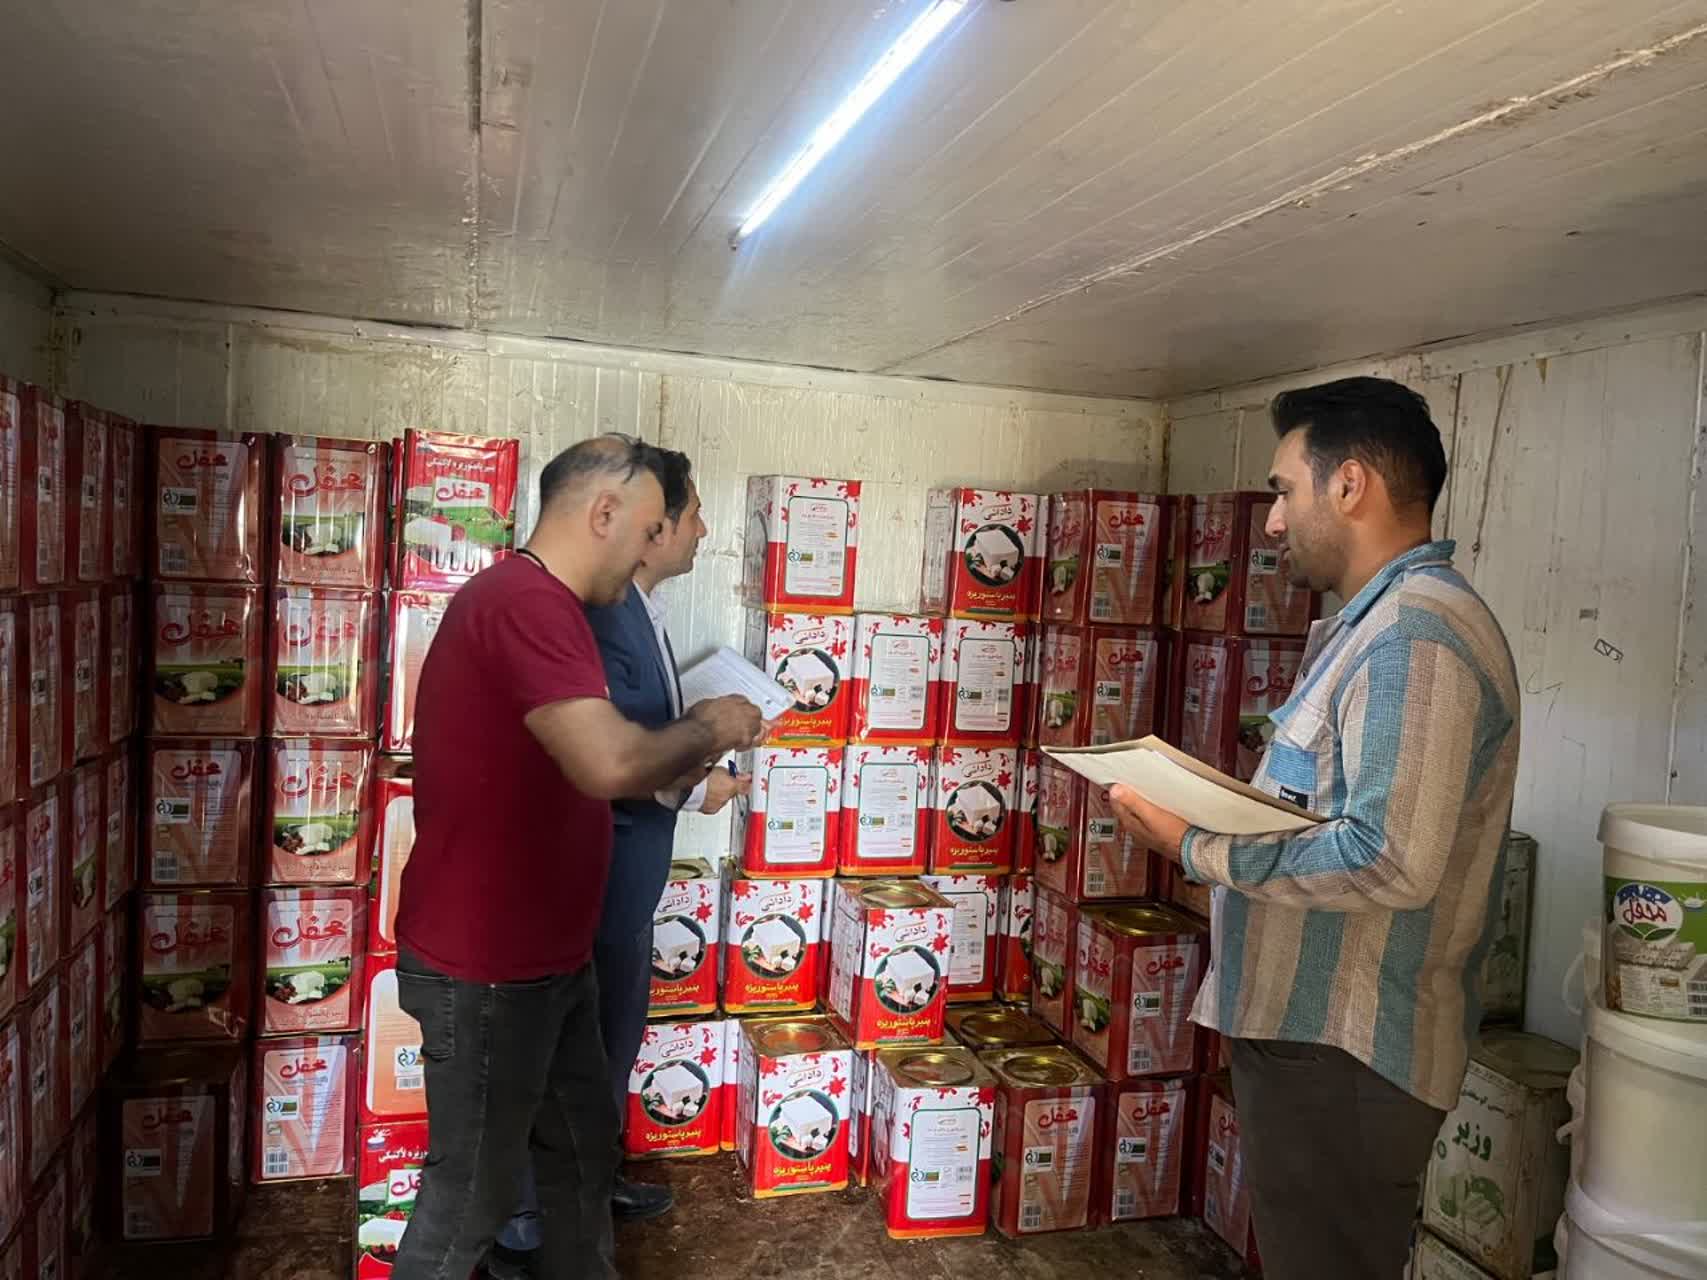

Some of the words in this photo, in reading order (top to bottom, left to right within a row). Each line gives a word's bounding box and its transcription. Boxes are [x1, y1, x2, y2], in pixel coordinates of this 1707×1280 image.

[288, 464, 366, 497] محفل
[436, 483, 486, 501] محفل
[1108, 510, 1145, 529] محفل
[1108, 648, 1144, 665] محفل
[171, 759, 222, 780] محفل
[272, 915, 346, 948] محفل
[1146, 954, 1185, 975] محفل
[280, 1056, 327, 1078] محفل
[1038, 1106, 1078, 1128] محفل
[1132, 1098, 1170, 1121] محفل
